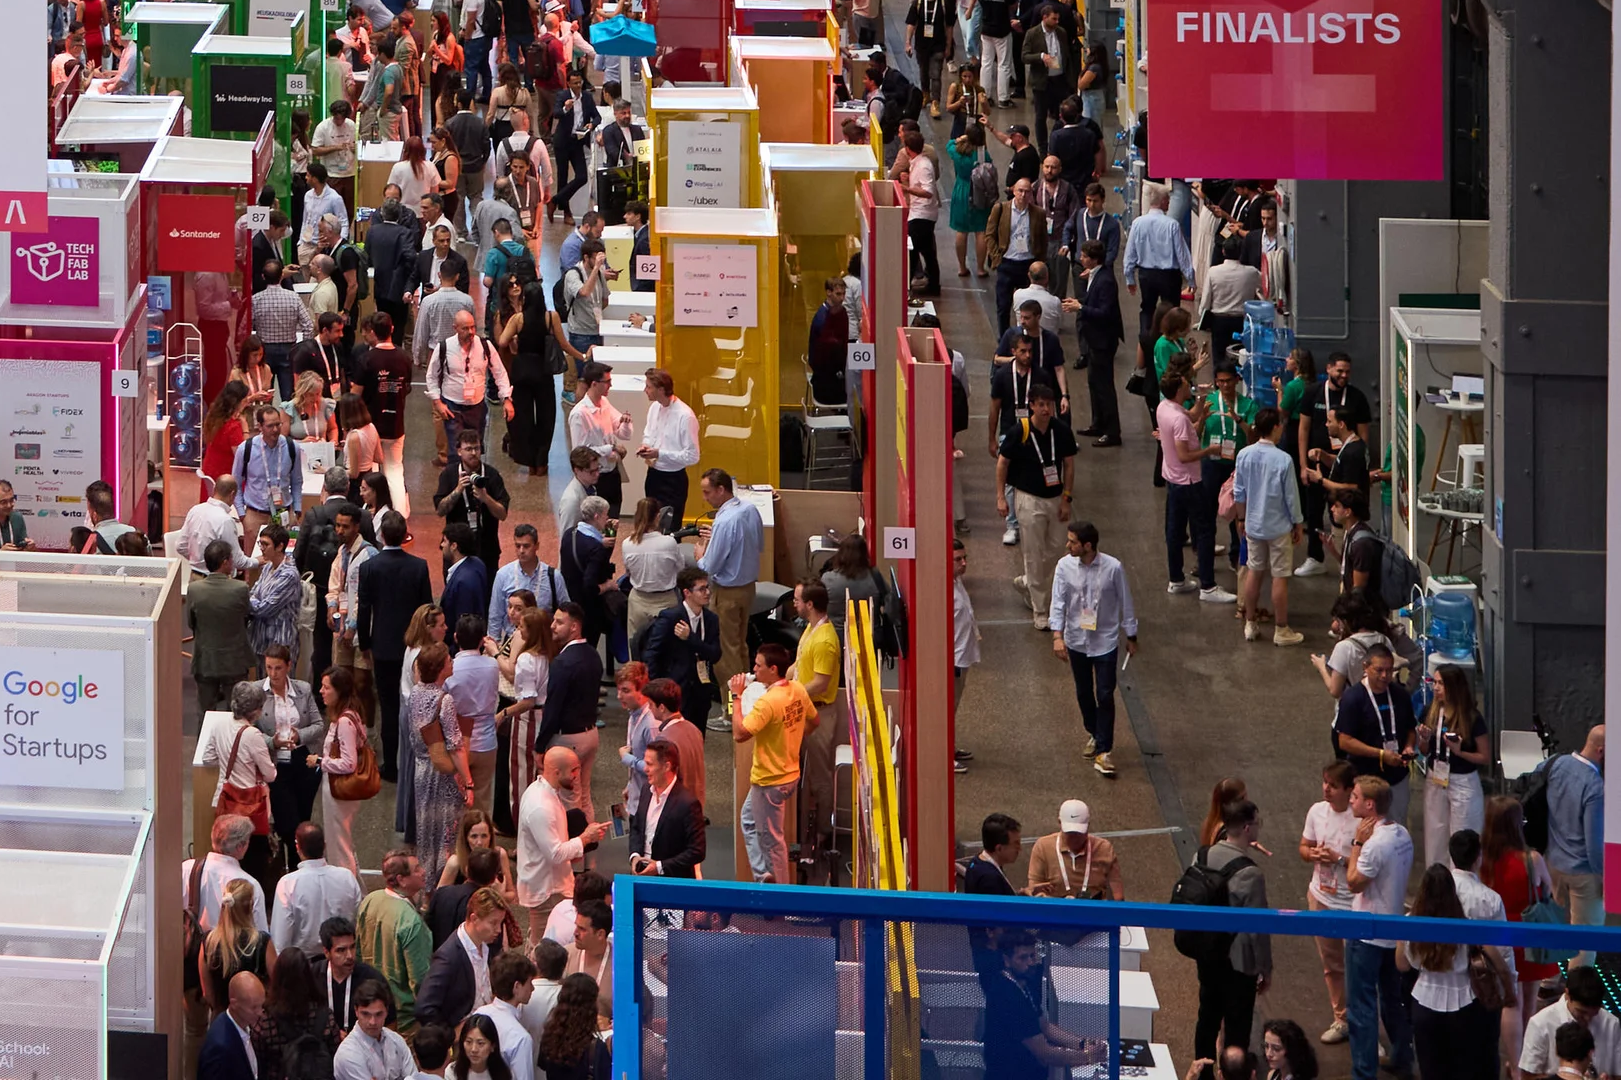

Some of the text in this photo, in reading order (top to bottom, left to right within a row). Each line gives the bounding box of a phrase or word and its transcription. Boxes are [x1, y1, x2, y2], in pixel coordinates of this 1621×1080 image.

[1176, 12, 1401, 44] FINALISTS
[290, 79, 303, 89] 88
[229, 94, 272, 104] Headway Inc
[252, 212, 265, 223] 87
[180, 229, 221, 240] Santander
[67, 243, 94, 254] TECH
[68, 258, 89, 269] FAB
[641, 263, 657, 273] 62
[68, 270, 89, 280] LAB
[853, 351, 871, 362] 60
[121, 378, 129, 389] 9
[892, 538, 908, 549] 61
[3, 671, 98, 704] Google
[4, 704, 39, 727] for
[3, 733, 107, 765] Startups
[0, 1056, 13, 1068] AI
